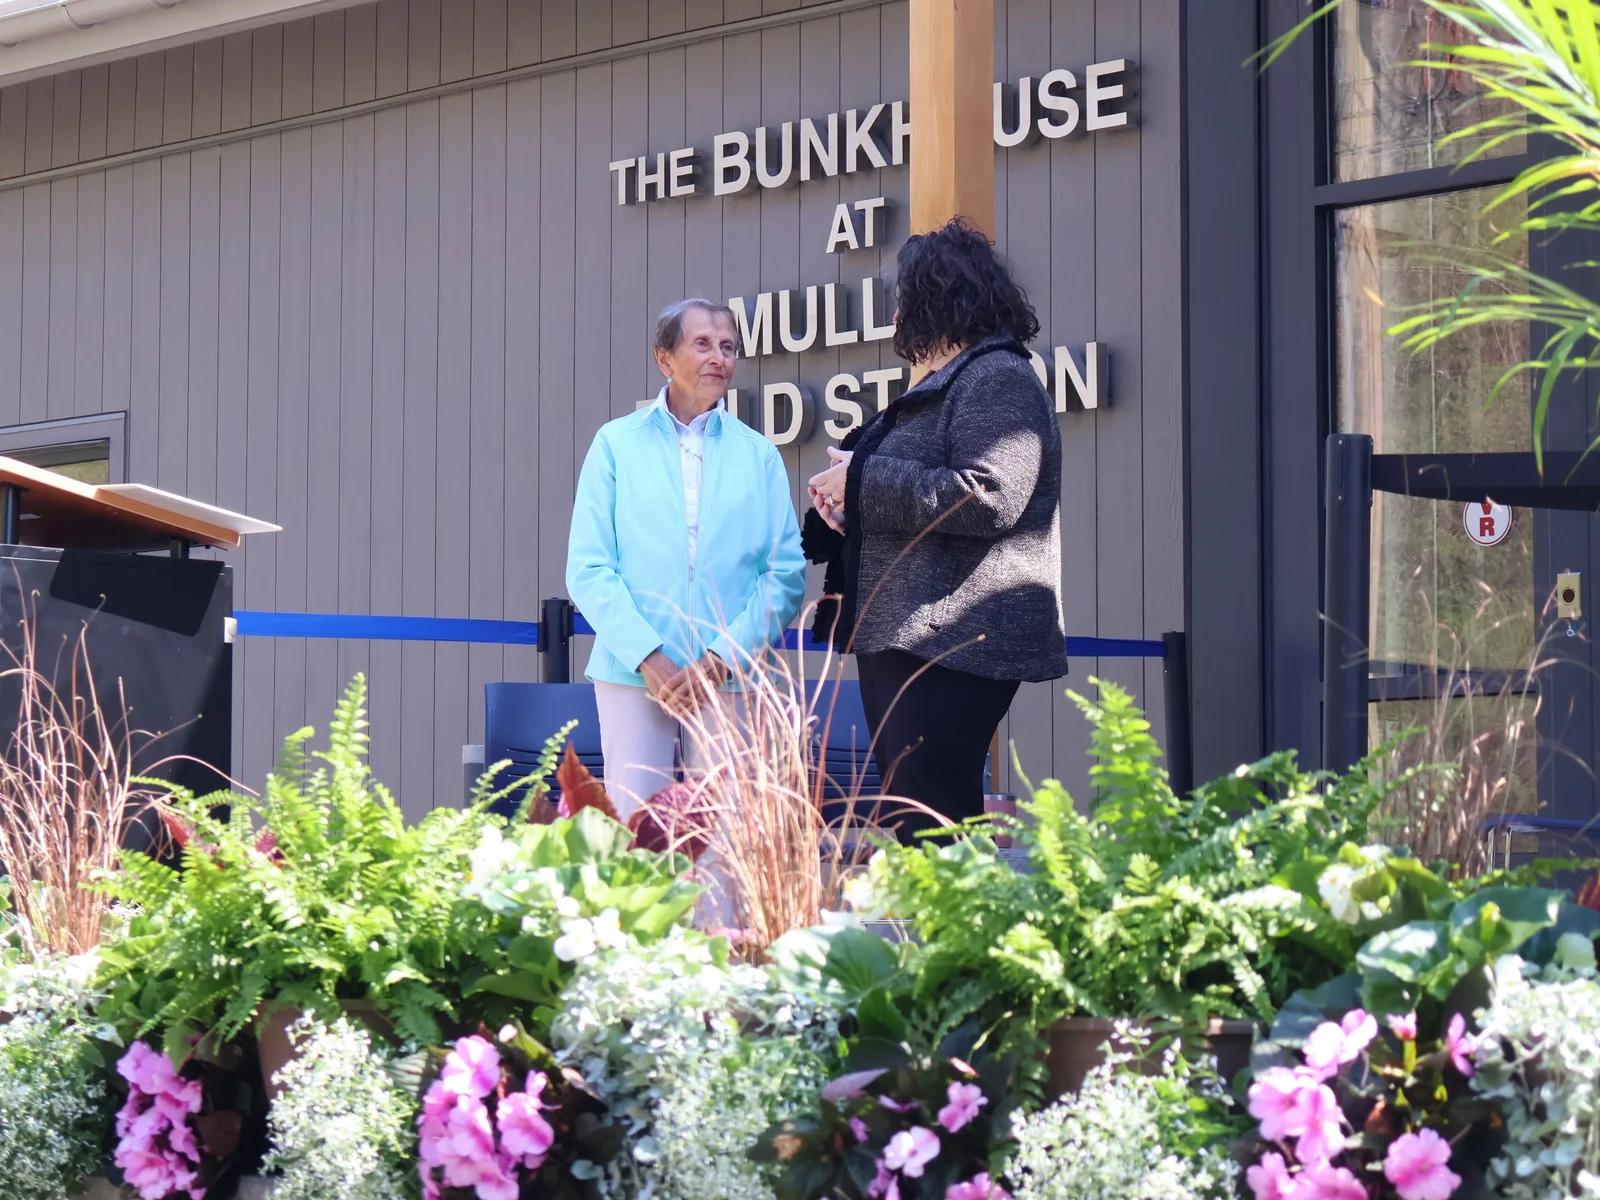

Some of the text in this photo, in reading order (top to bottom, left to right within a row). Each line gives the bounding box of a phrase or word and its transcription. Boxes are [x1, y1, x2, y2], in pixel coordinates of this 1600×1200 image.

[609, 58, 1128, 206] THE BUNKUSE
[825, 196, 885, 254] AT
[728, 277, 897, 359] MULL
[1479, 516, 1495, 537] R
